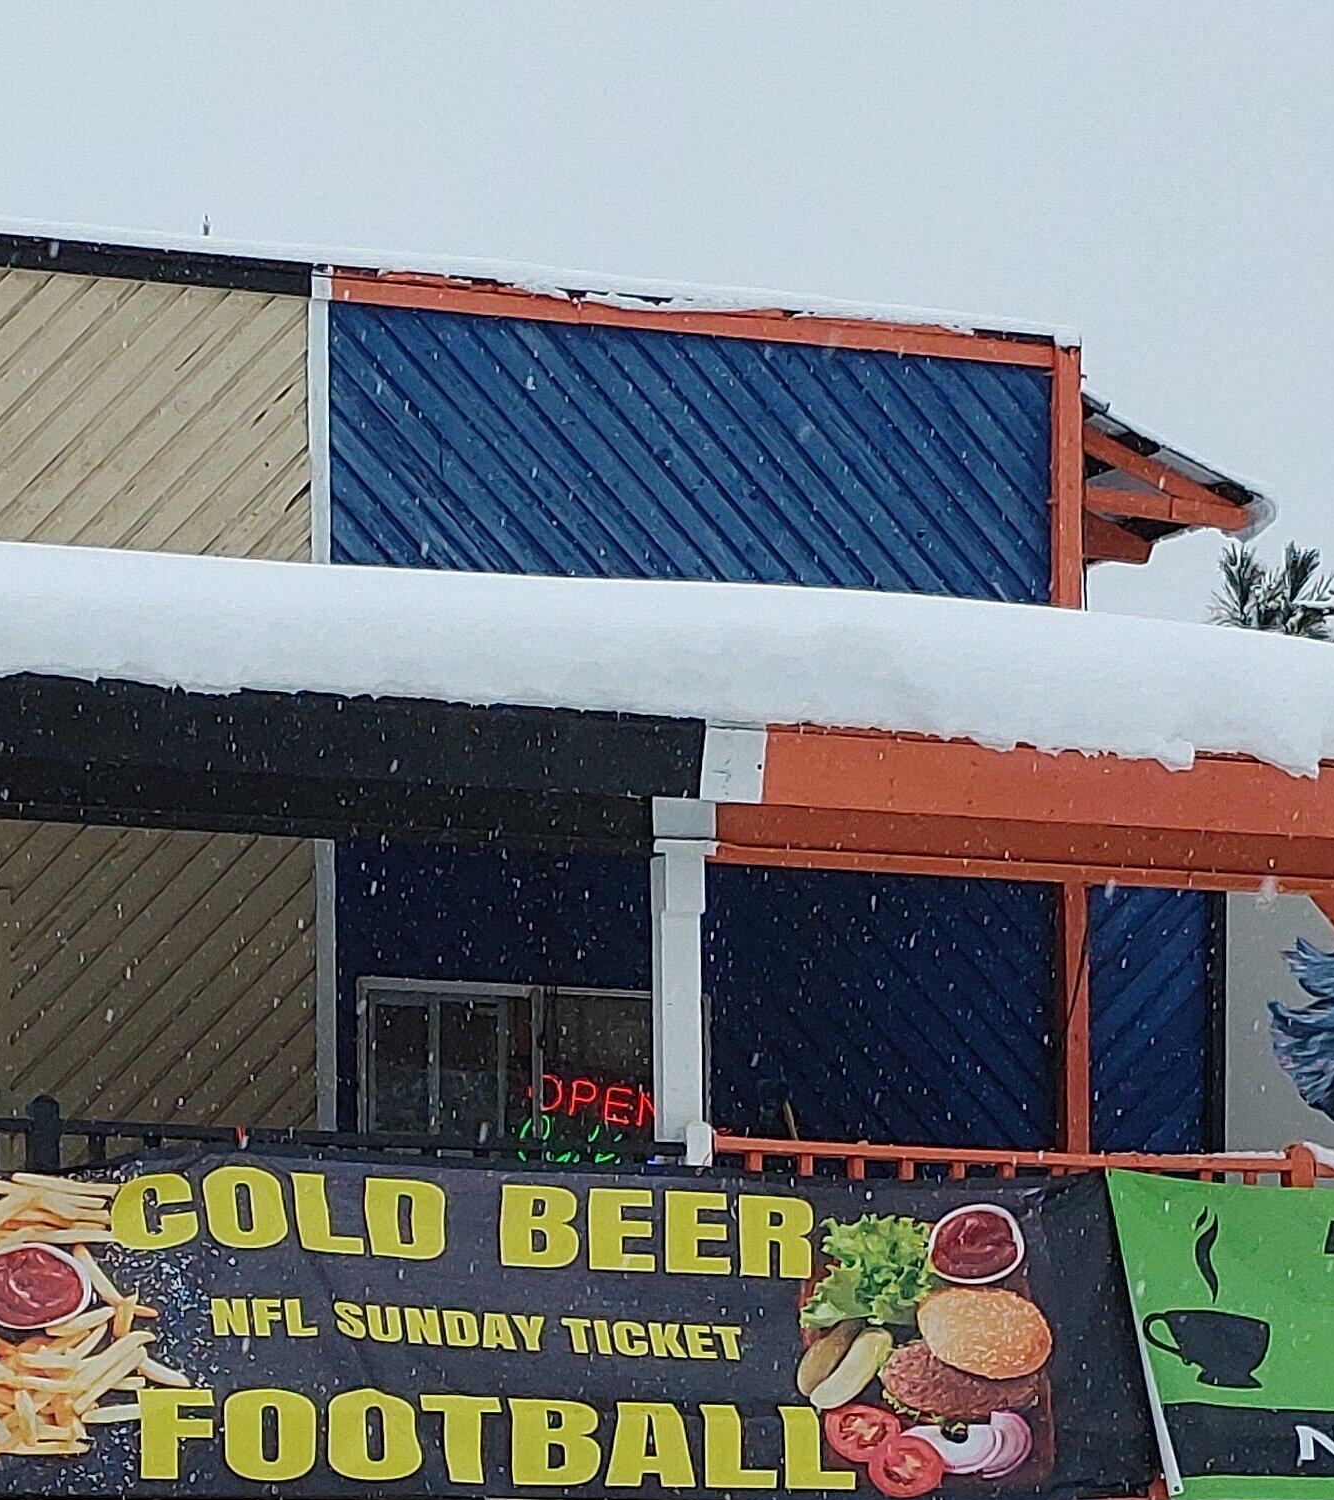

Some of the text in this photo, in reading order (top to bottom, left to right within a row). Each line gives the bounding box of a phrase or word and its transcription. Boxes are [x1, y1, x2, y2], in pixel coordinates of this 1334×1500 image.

[111, 1166, 814, 1279] COLD BEER
[210, 1298, 742, 1361] NFL SUNDAY TICKET
[140, 1386, 857, 1490] FOOTBALL
